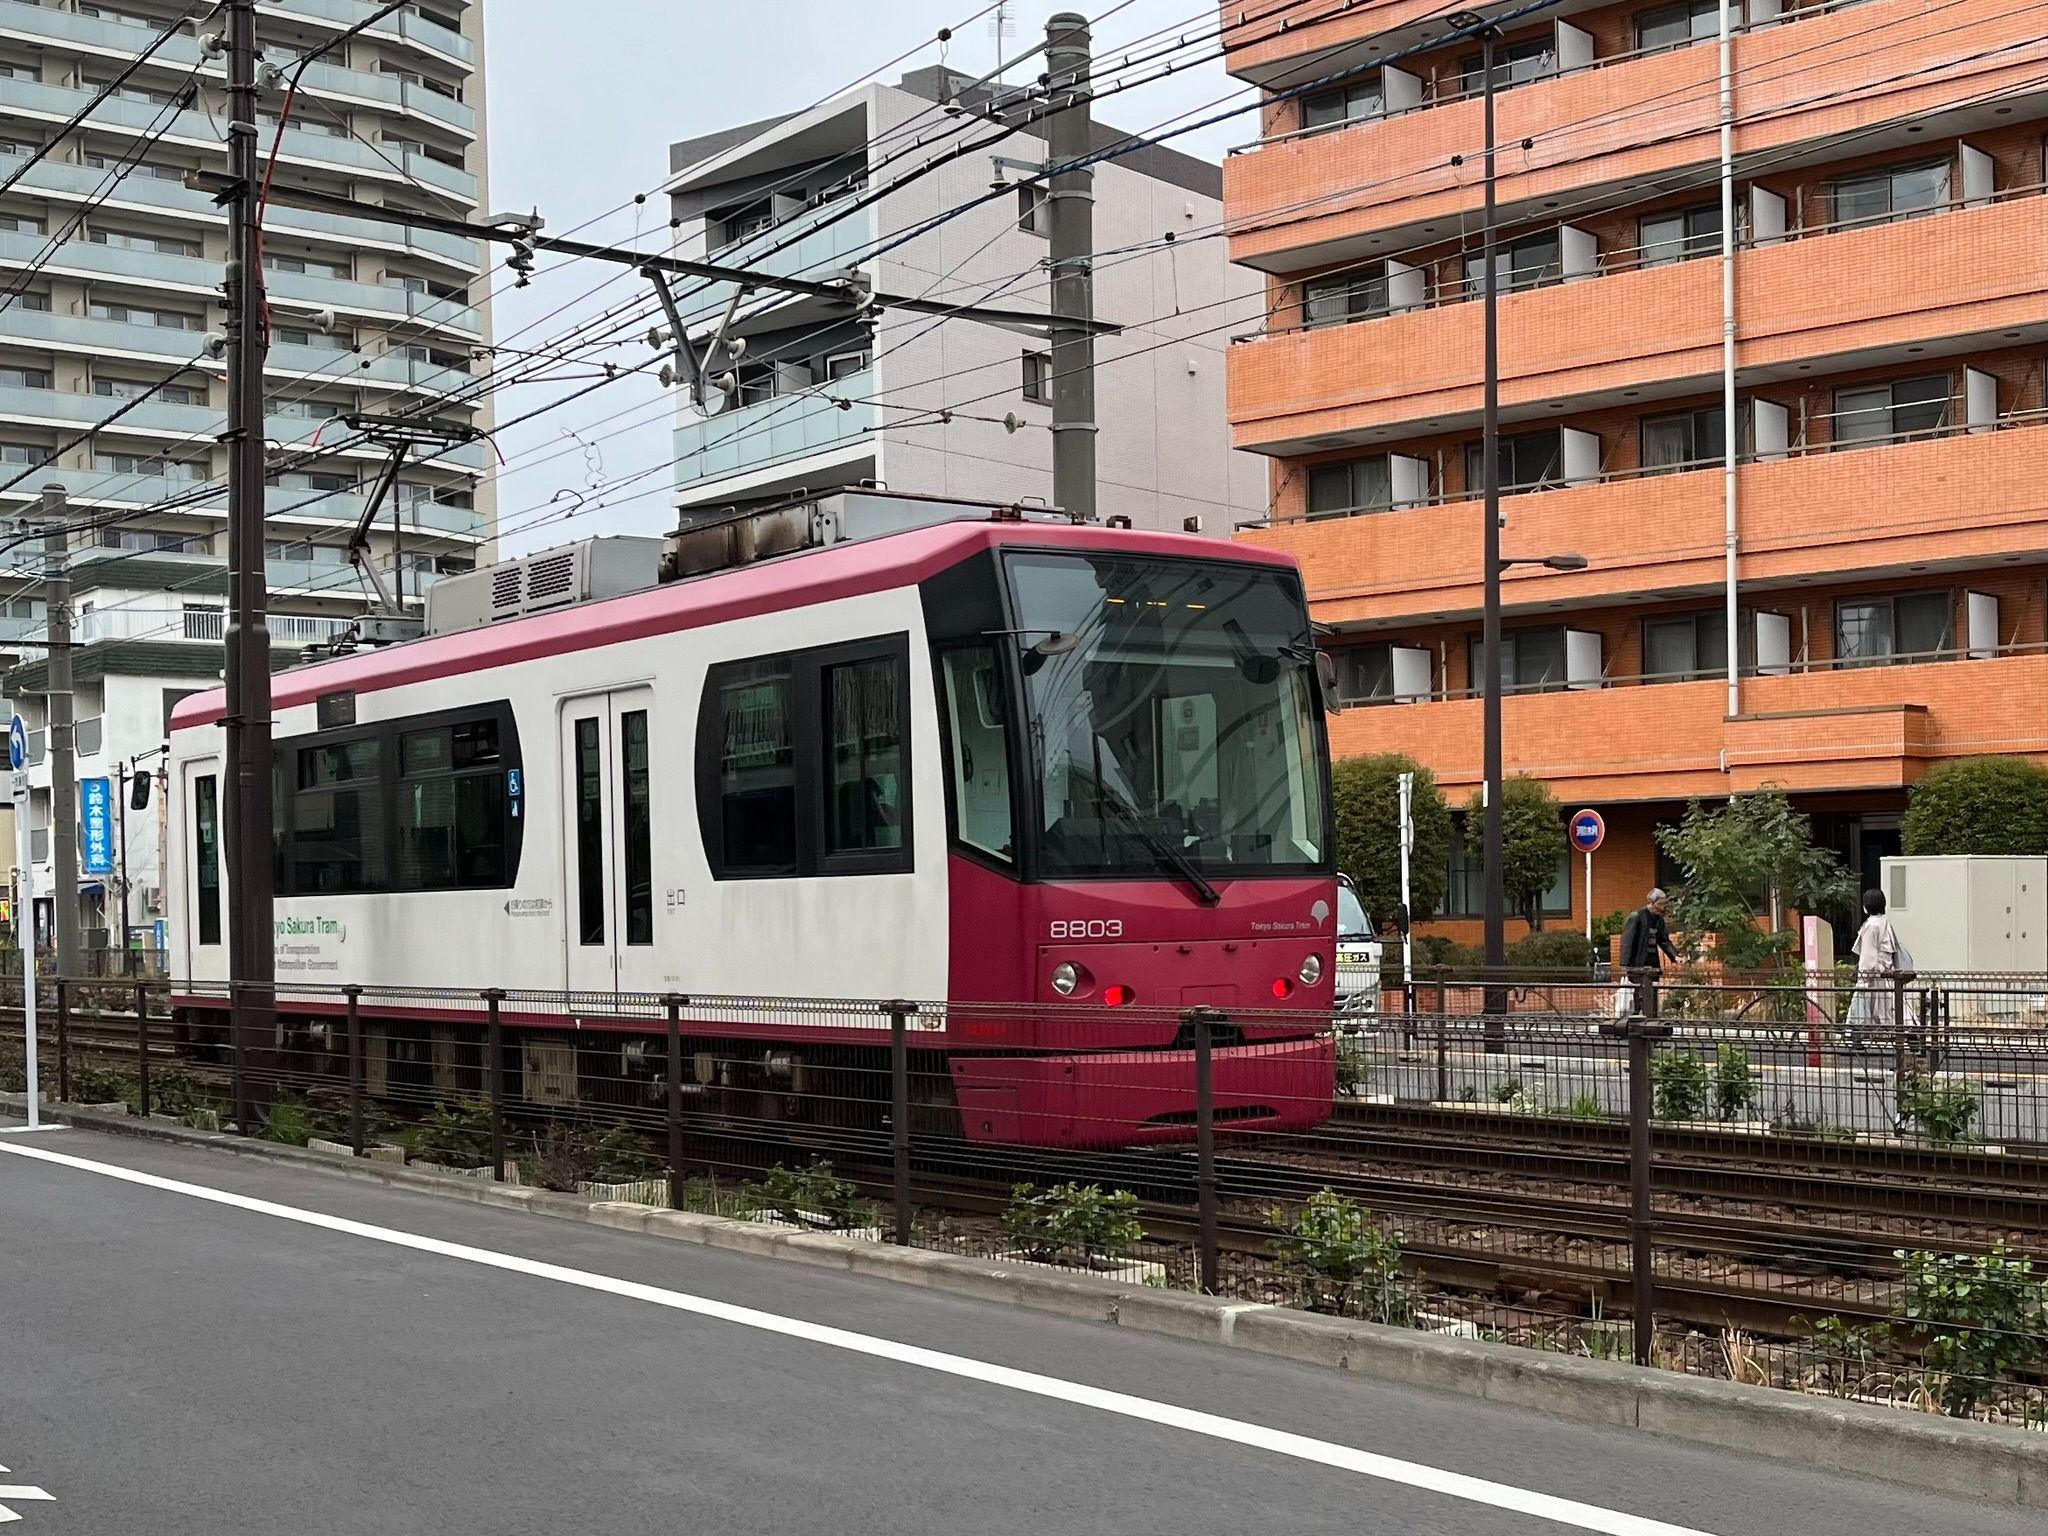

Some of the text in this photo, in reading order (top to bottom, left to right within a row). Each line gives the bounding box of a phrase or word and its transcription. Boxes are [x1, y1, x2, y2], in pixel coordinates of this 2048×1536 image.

[286, 916, 314, 934] Sakura
[316, 916, 337, 934] Tram
[1050, 919, 1123, 938] 8803
